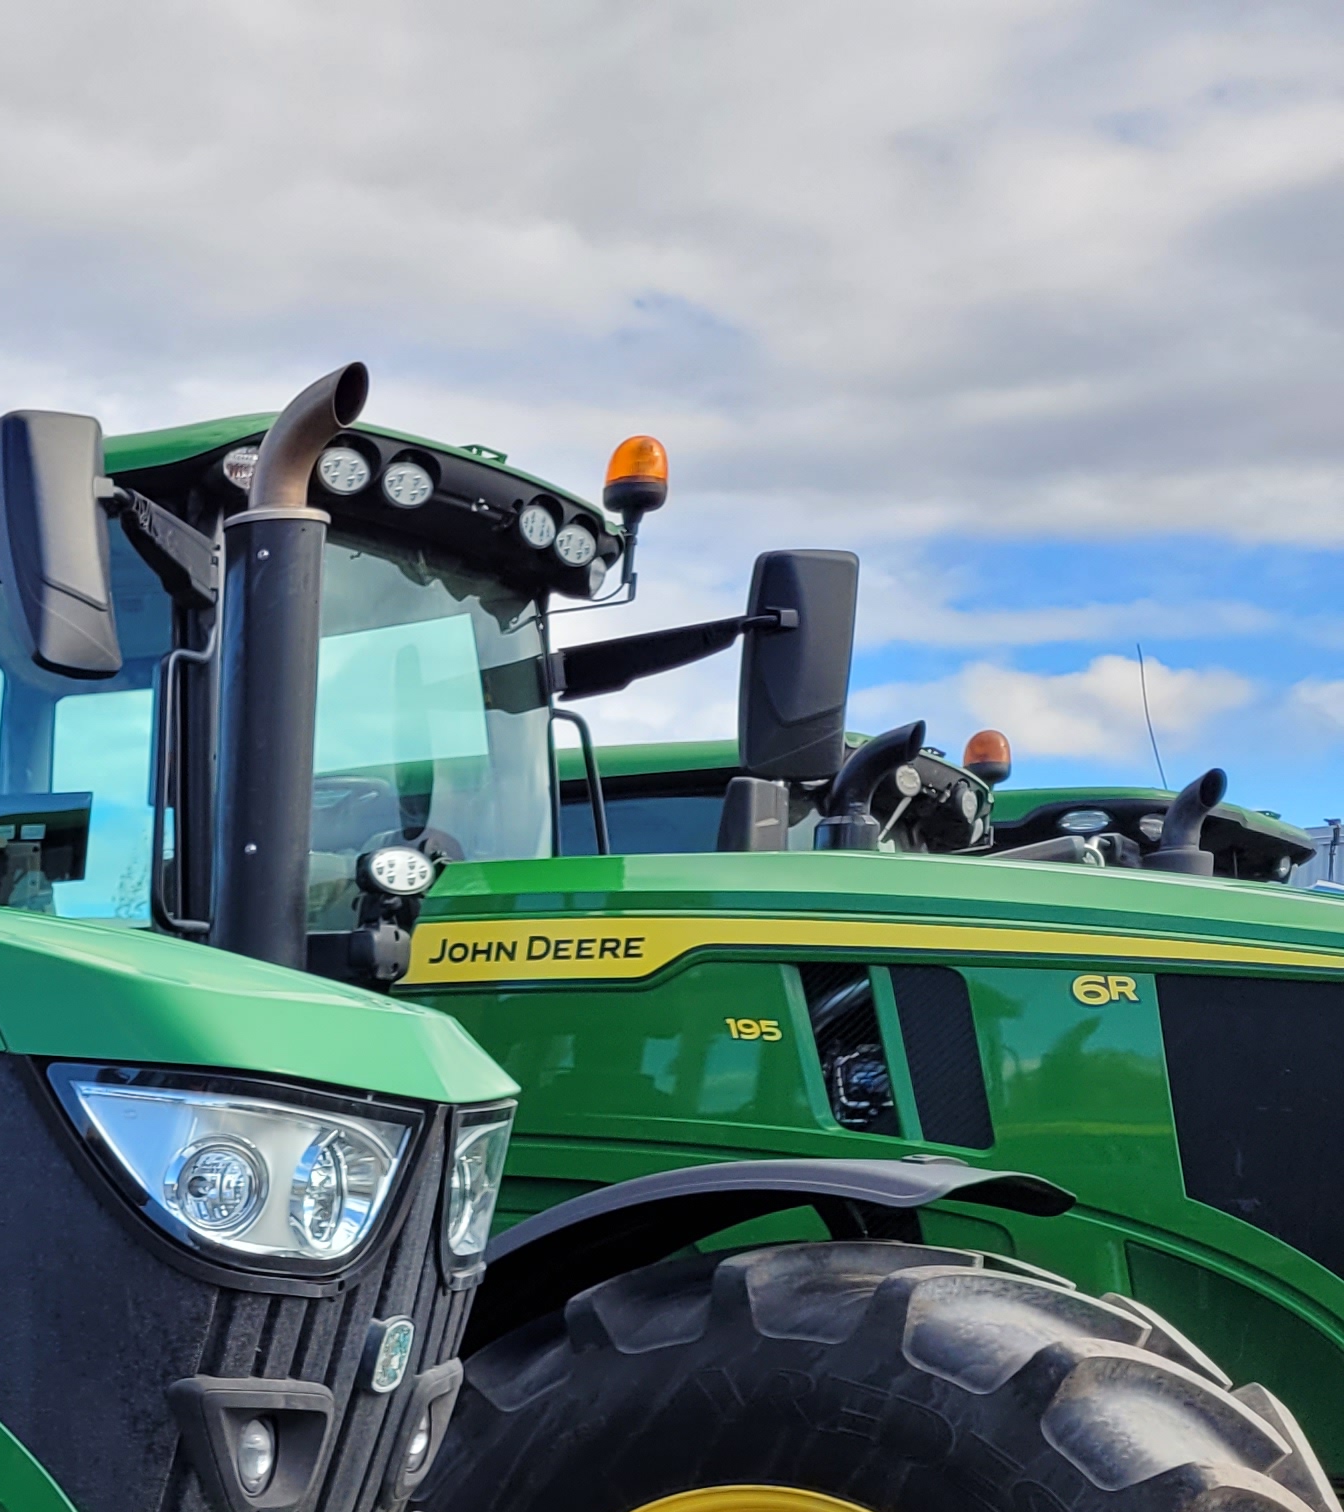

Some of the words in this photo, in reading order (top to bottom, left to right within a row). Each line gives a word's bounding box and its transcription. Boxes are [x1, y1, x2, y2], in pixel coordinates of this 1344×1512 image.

[428, 938, 518, 963] JOHN
[526, 935, 646, 961] DEERE
[1072, 974, 1140, 1006] 6R
[725, 1018, 783, 1041] 195
